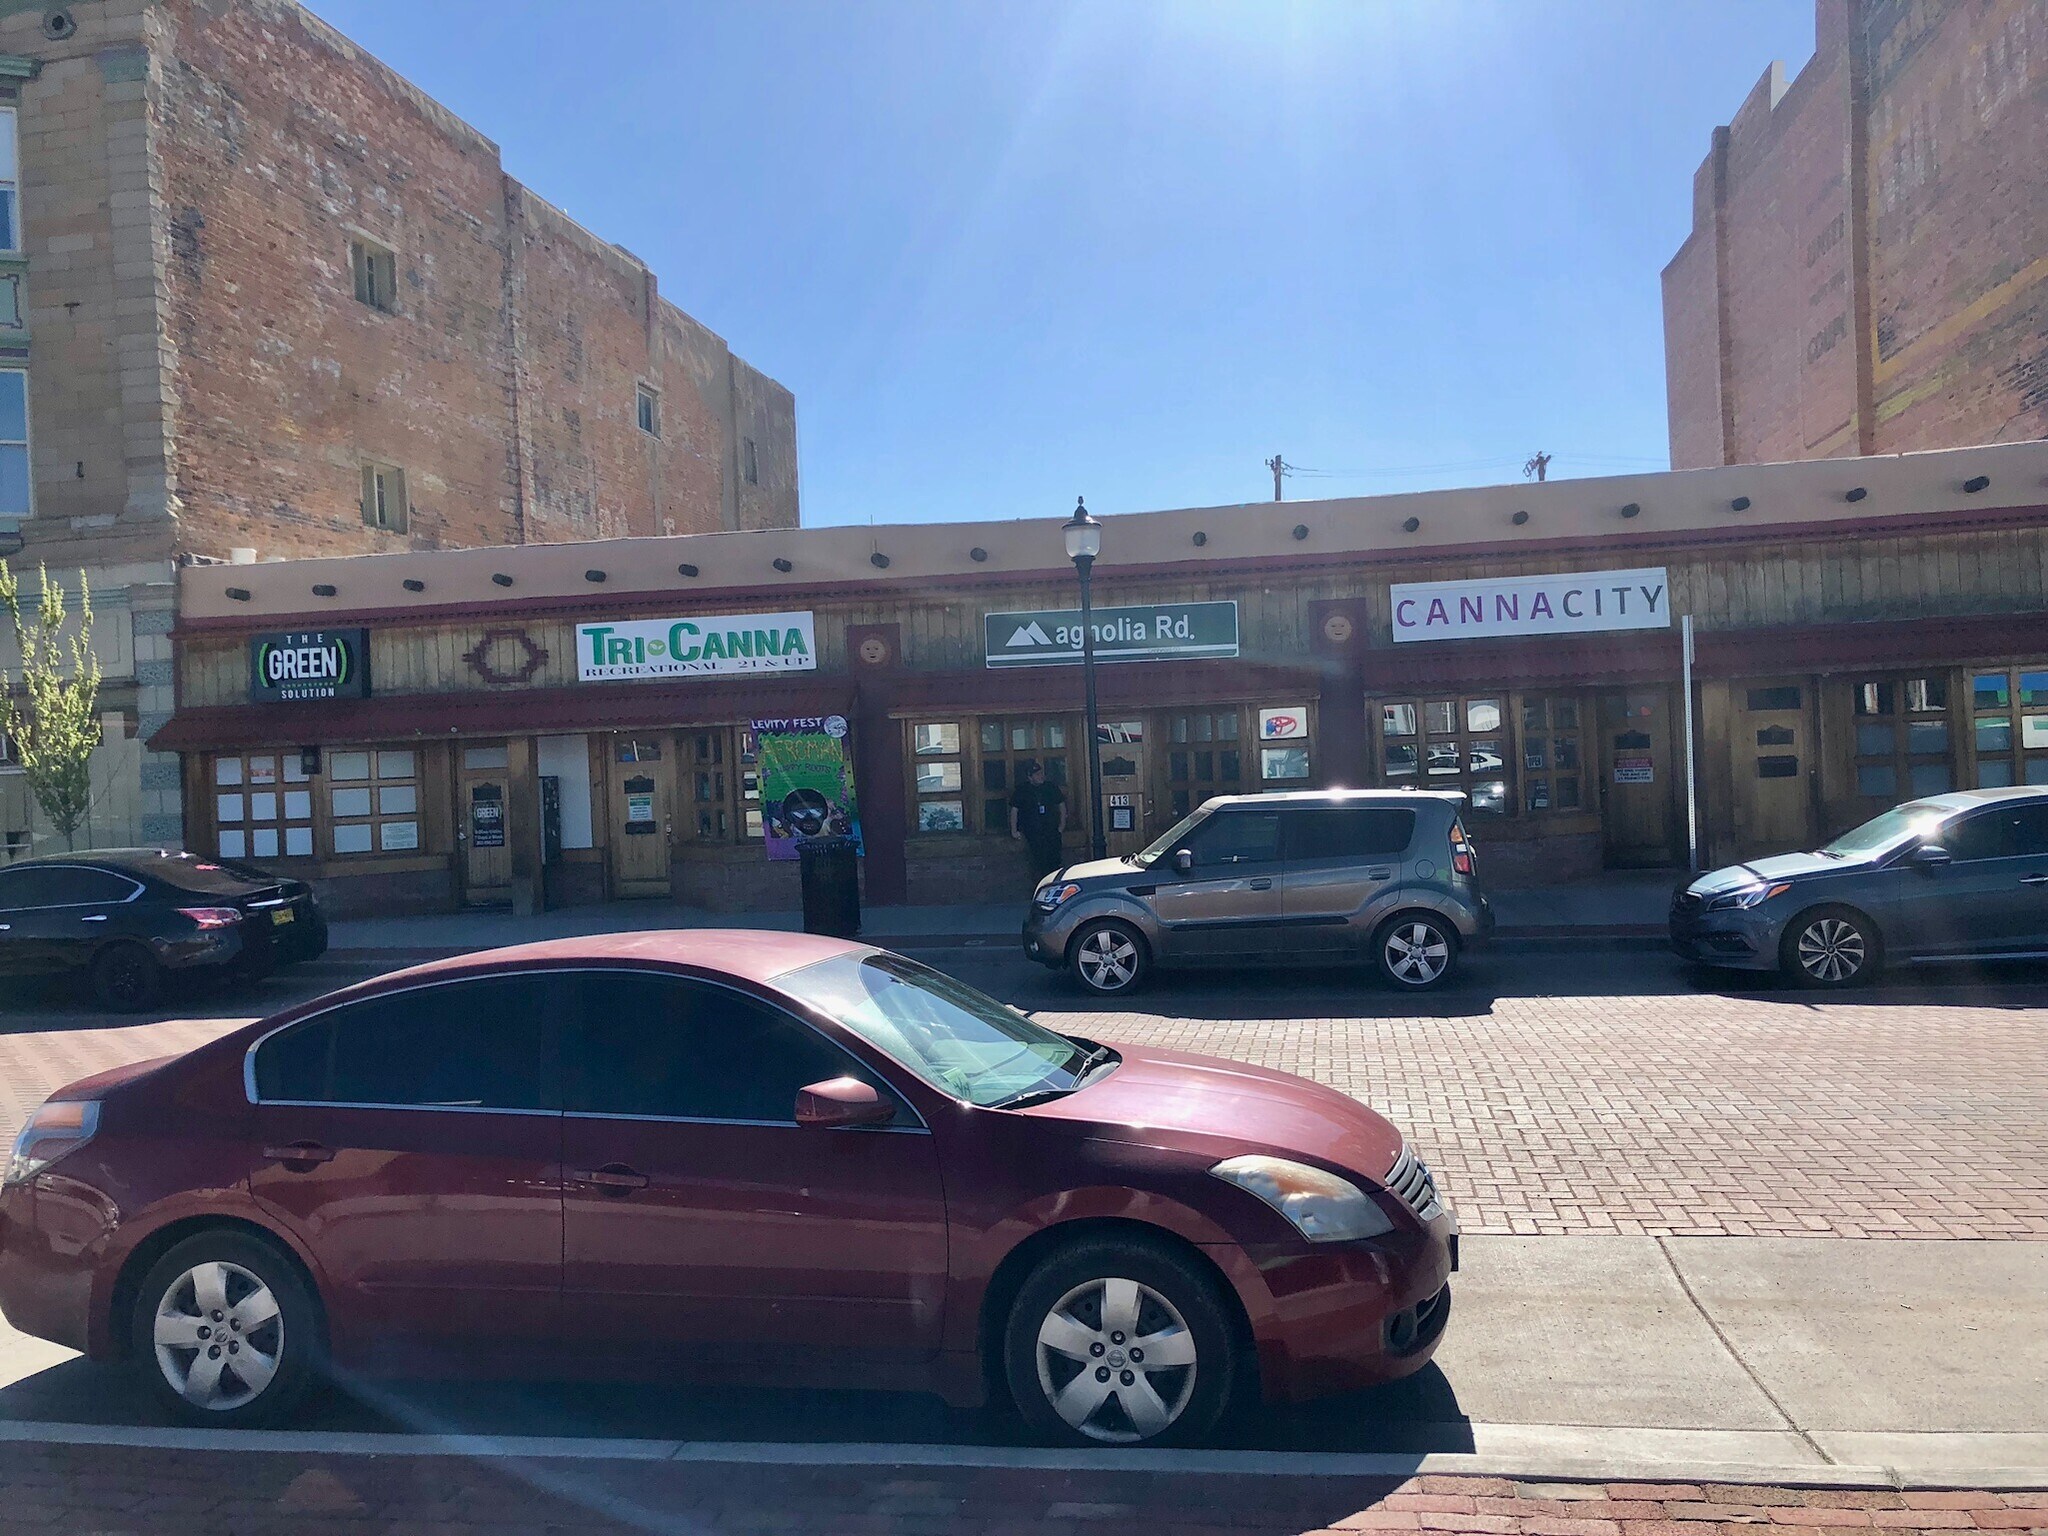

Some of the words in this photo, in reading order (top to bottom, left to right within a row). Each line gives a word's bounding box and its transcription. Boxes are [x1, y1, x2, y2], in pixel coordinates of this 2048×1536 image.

[1396, 584, 1664, 628] CANNACITY
[1155, 614, 1196, 640] Rd.
[286, 633, 324, 645] THE
[268, 646, 337, 680] GREEN
[585, 661, 723, 677] RECREATIONAL
[738, 660, 757, 668] 21
[764, 659, 778, 667] &
[785, 657, 809, 667] UP
[281, 687, 335, 699] SOLUTION
[751, 719, 789, 730] LEVITY
[793, 717, 823, 728] FEST
[763, 738, 844, 766] AFROMAN
[1110, 795, 1129, 806] 413
[476, 807, 499, 818] GREEN
